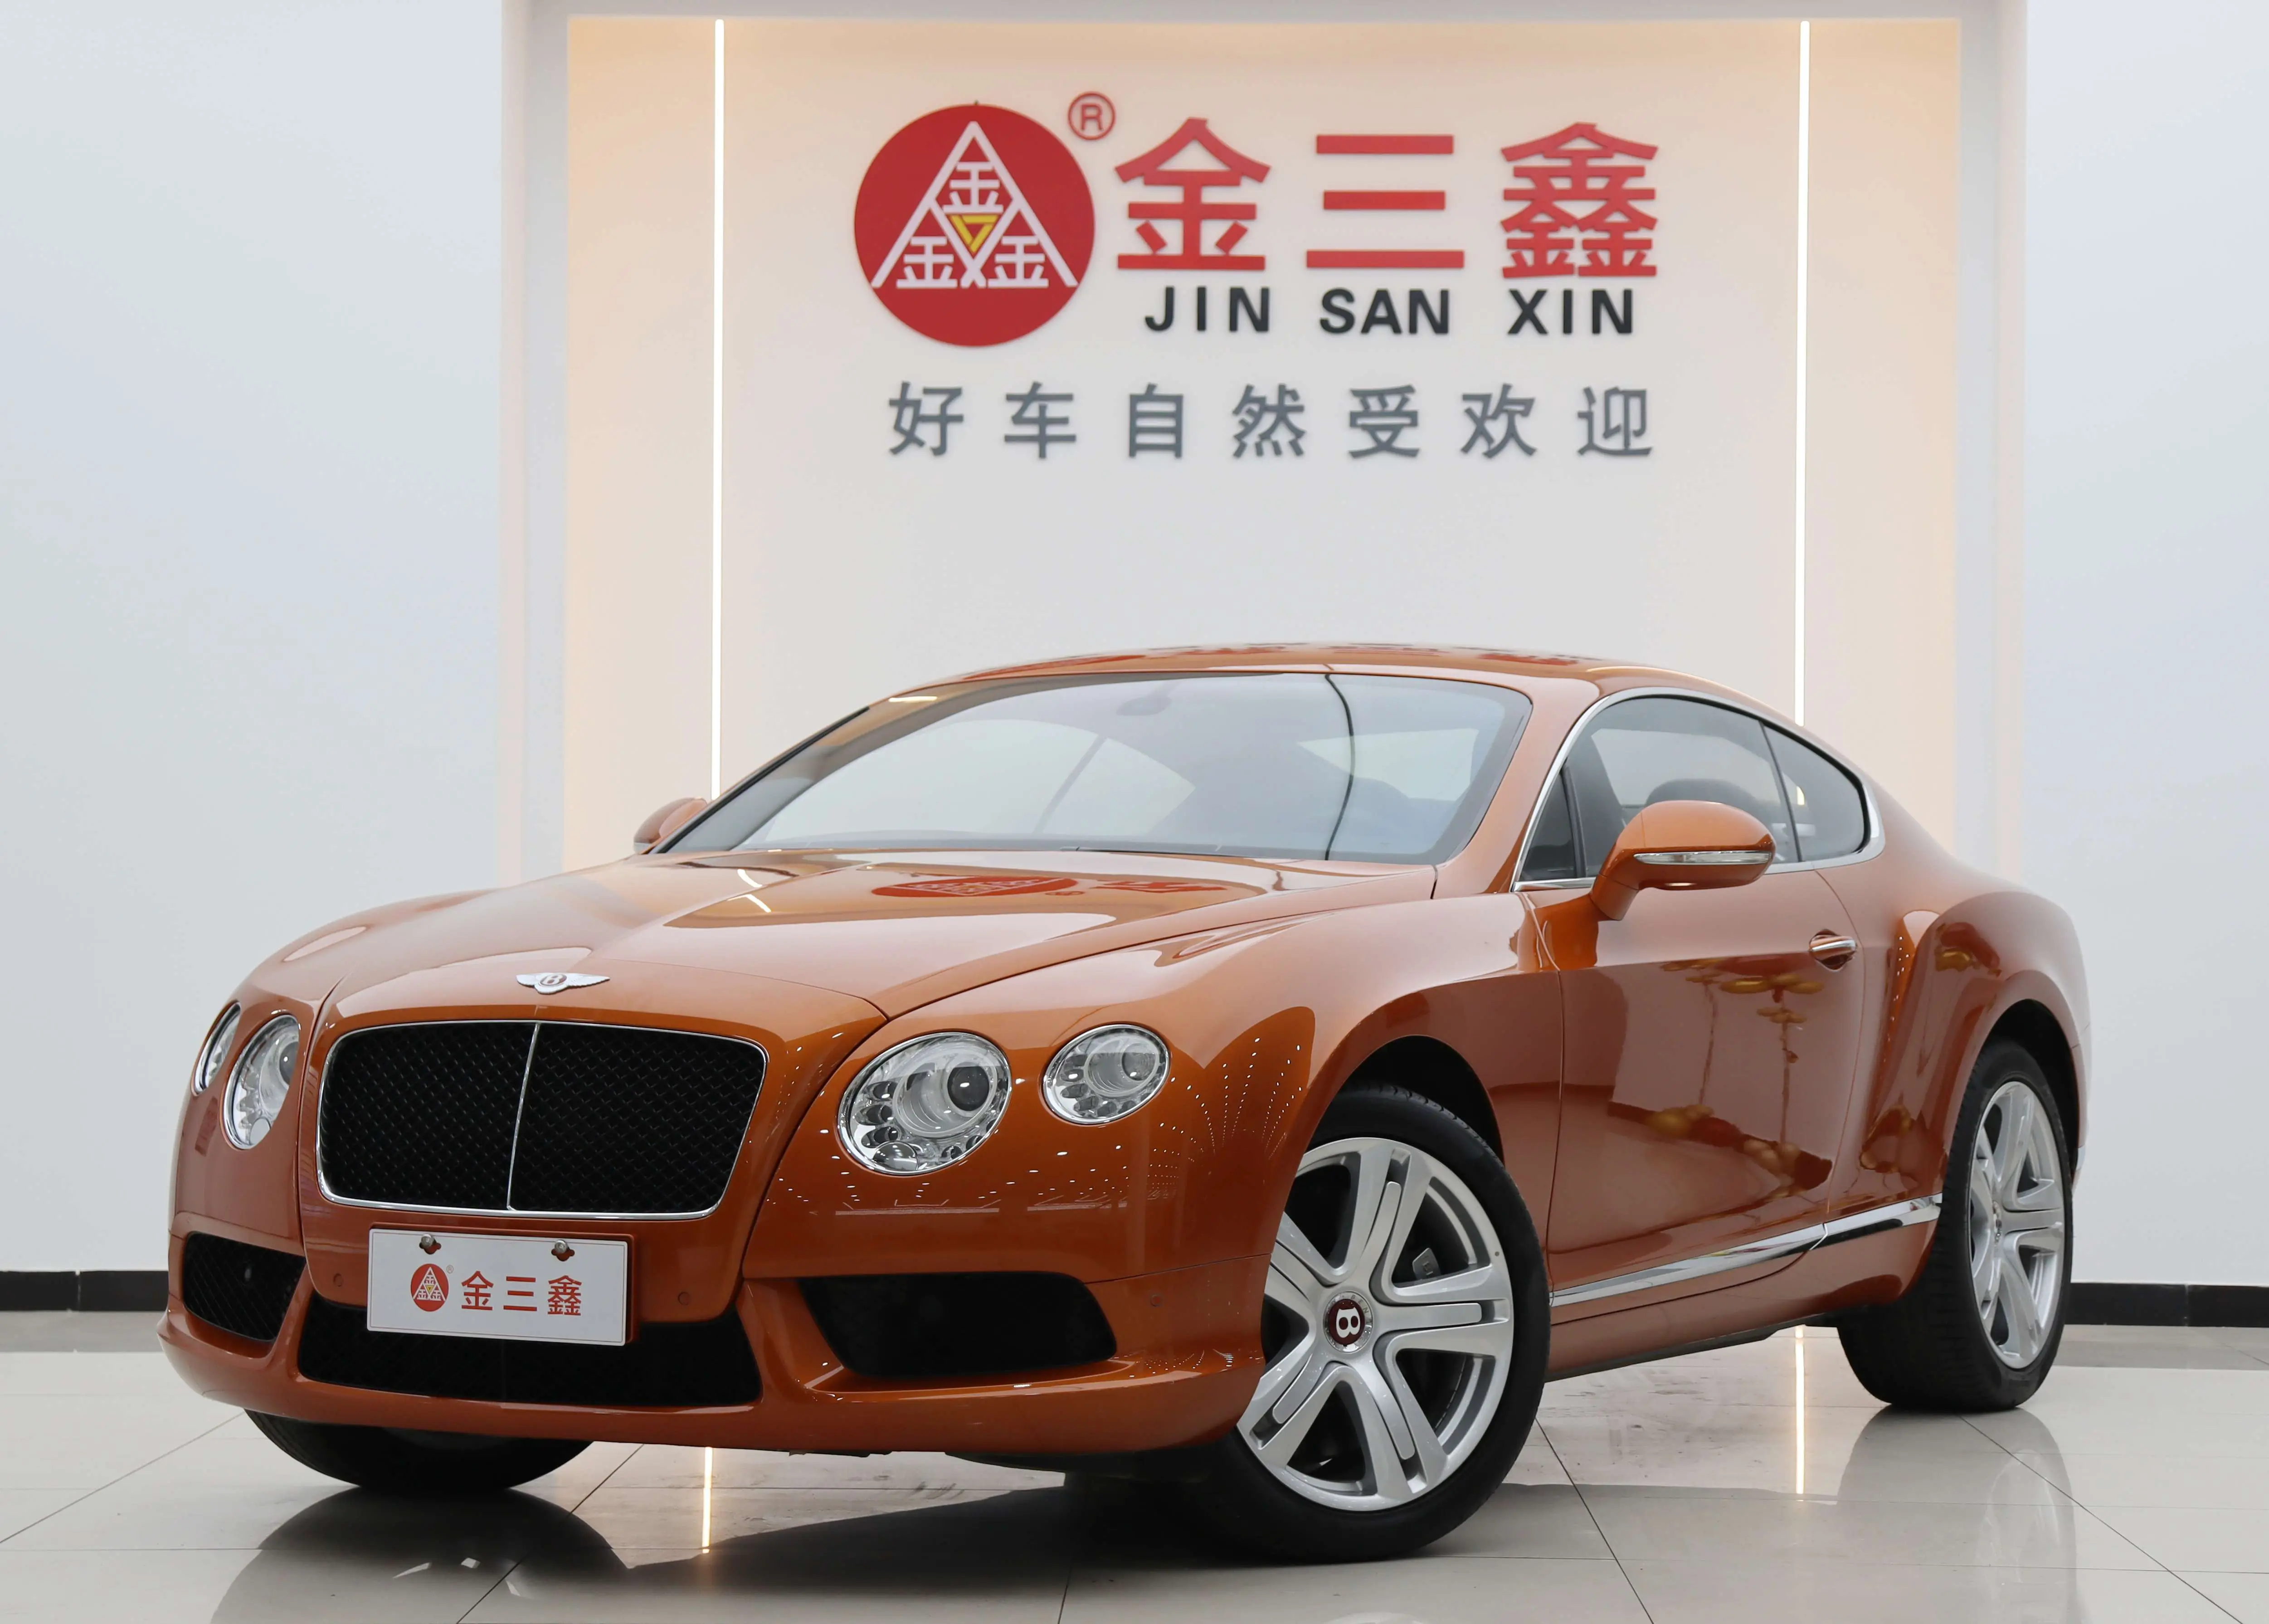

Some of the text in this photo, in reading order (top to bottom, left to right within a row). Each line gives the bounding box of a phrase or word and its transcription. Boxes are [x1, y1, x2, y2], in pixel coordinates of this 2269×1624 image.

[1115, 117, 1659, 278] 金三鑫
[1144, 287, 1633, 335] JIN SAN XIN
[888, 381, 1653, 460] 好车自然受欢迎
[461, 1270, 582, 1316] 金三鑫
